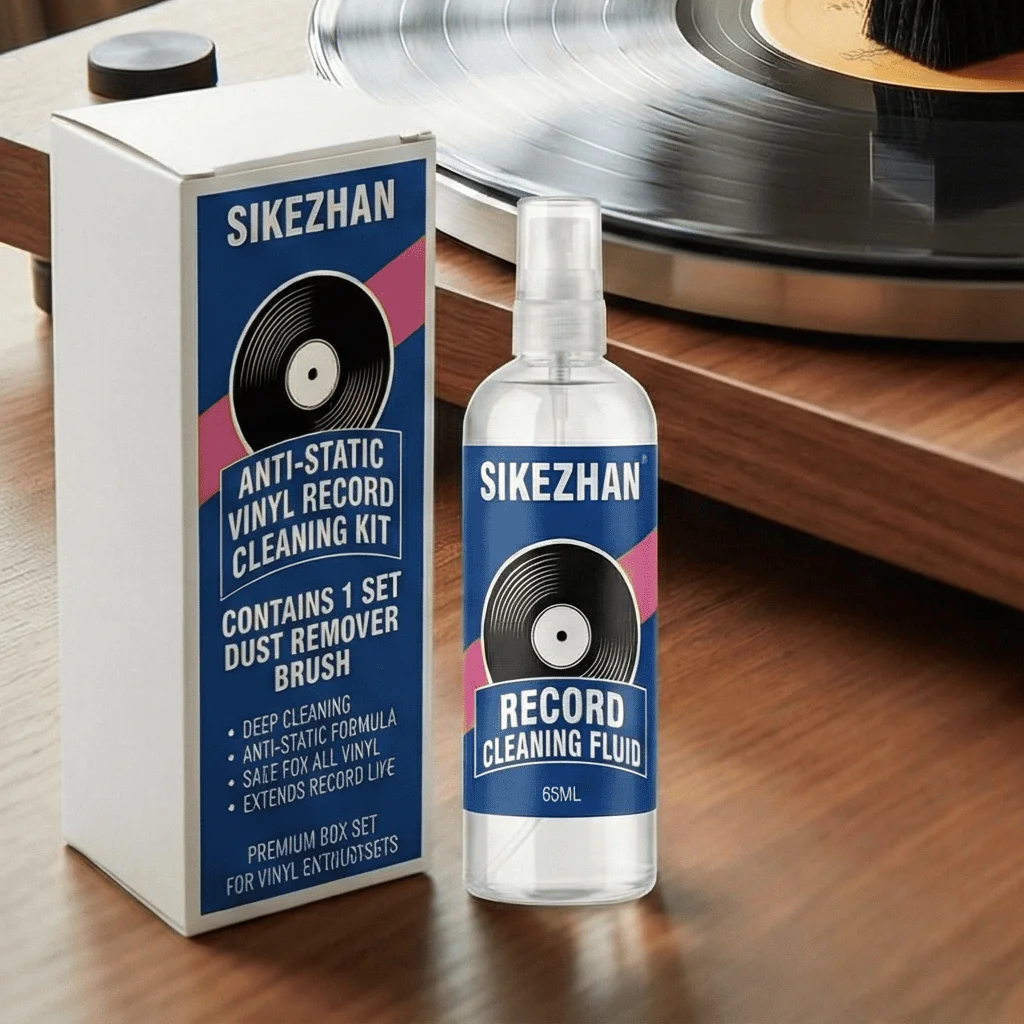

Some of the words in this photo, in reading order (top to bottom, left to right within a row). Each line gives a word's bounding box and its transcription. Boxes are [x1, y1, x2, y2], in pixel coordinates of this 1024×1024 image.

[227, 179, 395, 247] SIKEZHAN
[238, 438, 384, 499] ANTI-STATIC
[480, 460, 640, 501] SIKEZHAN
[228, 489, 294, 541] VINYL
[303, 476, 394, 514] RECORD
[232, 515, 347, 579] CLEANING
[355, 514, 391, 545] KIT
[222, 587, 334, 637] CONTAINS
[342, 582, 351, 608] 1
[362, 571, 401, 605] SET
[225, 632, 283, 671] DUST
[291, 605, 399, 655] REMOVER
[275, 648, 350, 692] BRUSH
[243, 713, 278, 739] DEEP
[283, 694, 351, 728] CLEANING
[500, 686, 624, 730] RECORD
[243, 726, 327, 764] ANTI-STATIC
[312, 748, 338, 772] ALL
[342, 737, 380, 763] VINYL
[483, 729, 581, 768] CLEANING
[590, 730, 641, 767] FLUID
[243, 781, 305, 813] EXTENDS
[310, 766, 363, 797] RECORD
[248, 830, 315, 864] PREMIUM
[320, 821, 348, 847] BOX
[352, 814, 378, 838] SET
[226, 874, 253, 896] FOR
[258, 861, 299, 889] VINYL
